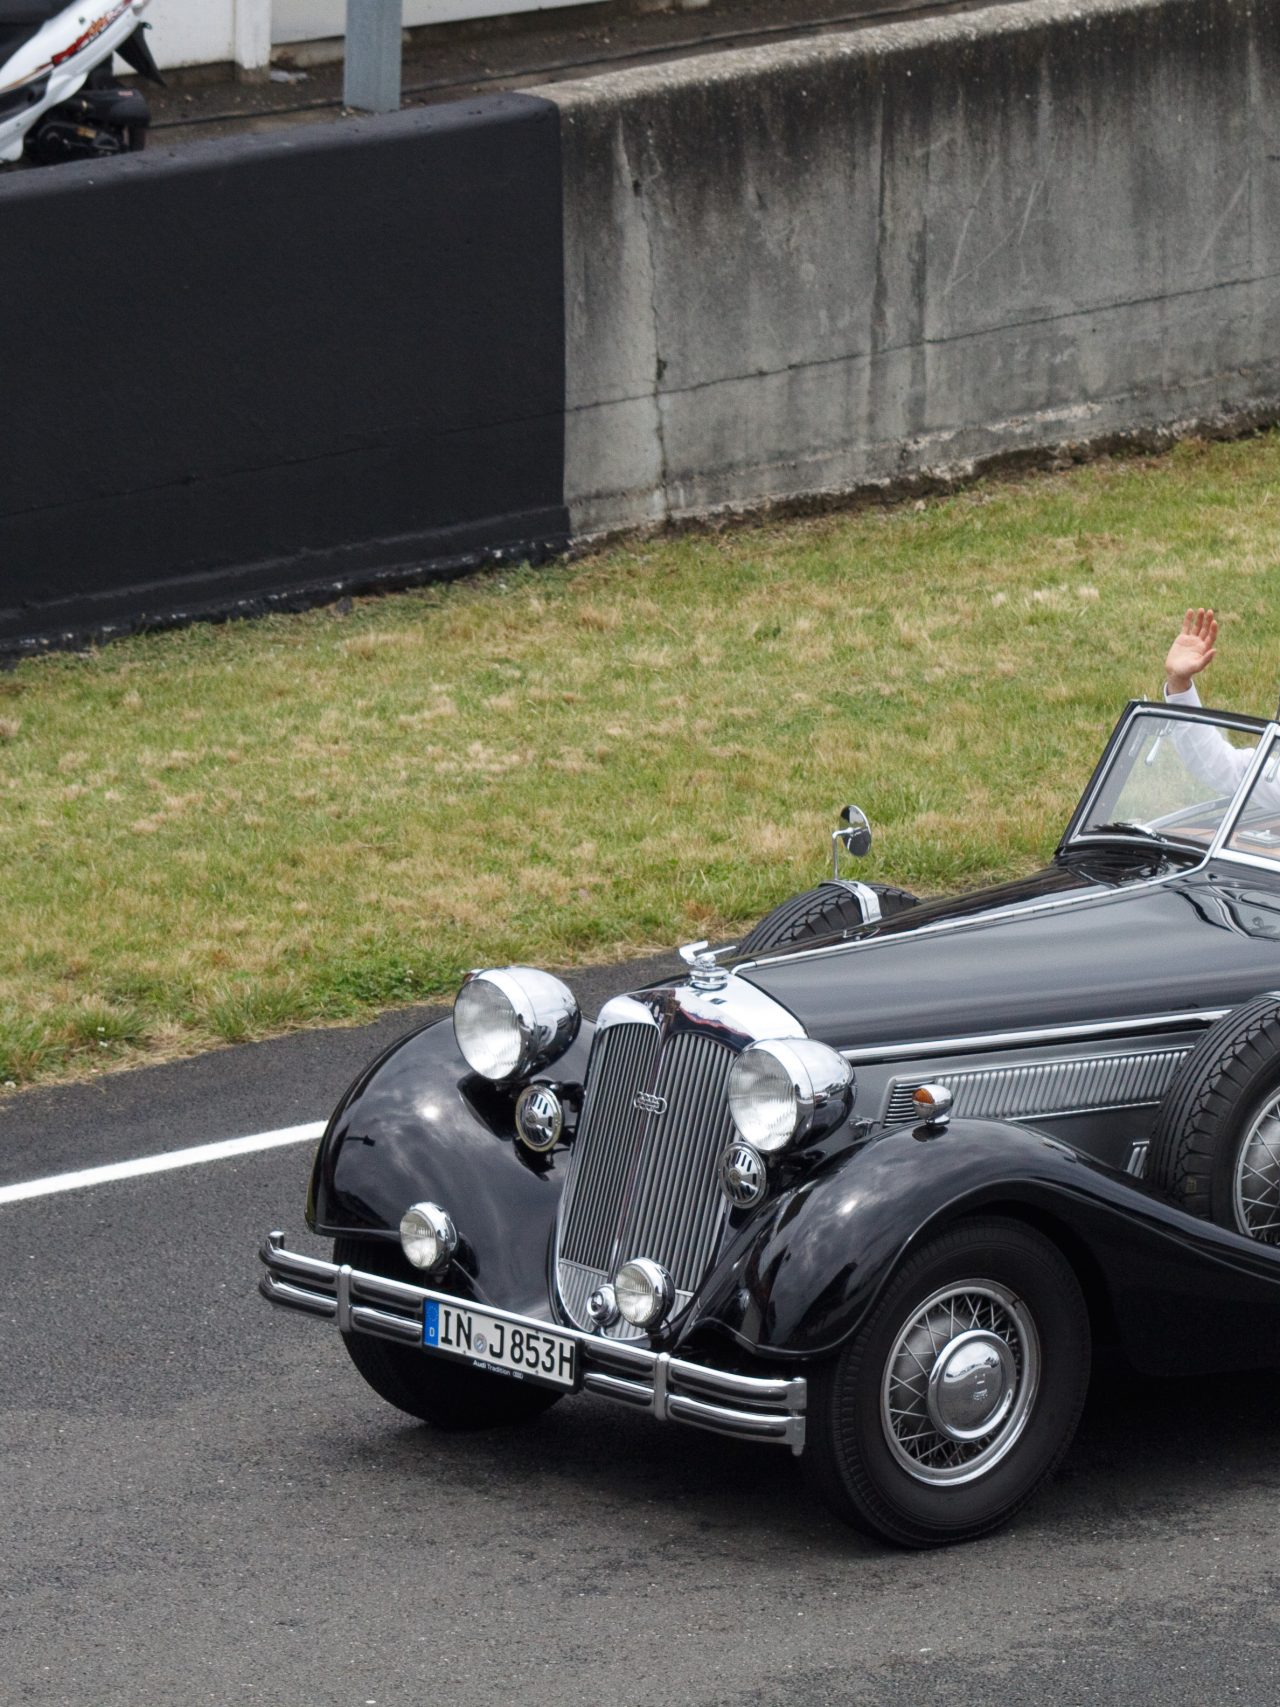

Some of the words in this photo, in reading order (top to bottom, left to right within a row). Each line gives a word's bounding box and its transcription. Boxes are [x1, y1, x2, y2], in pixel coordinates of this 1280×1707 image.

[429, 1326, 435, 1338] D
[441, 1309, 473, 1351] IN
[473, 1359, 487, 1369] Audi
[487, 1363, 511, 1376] Tradition
